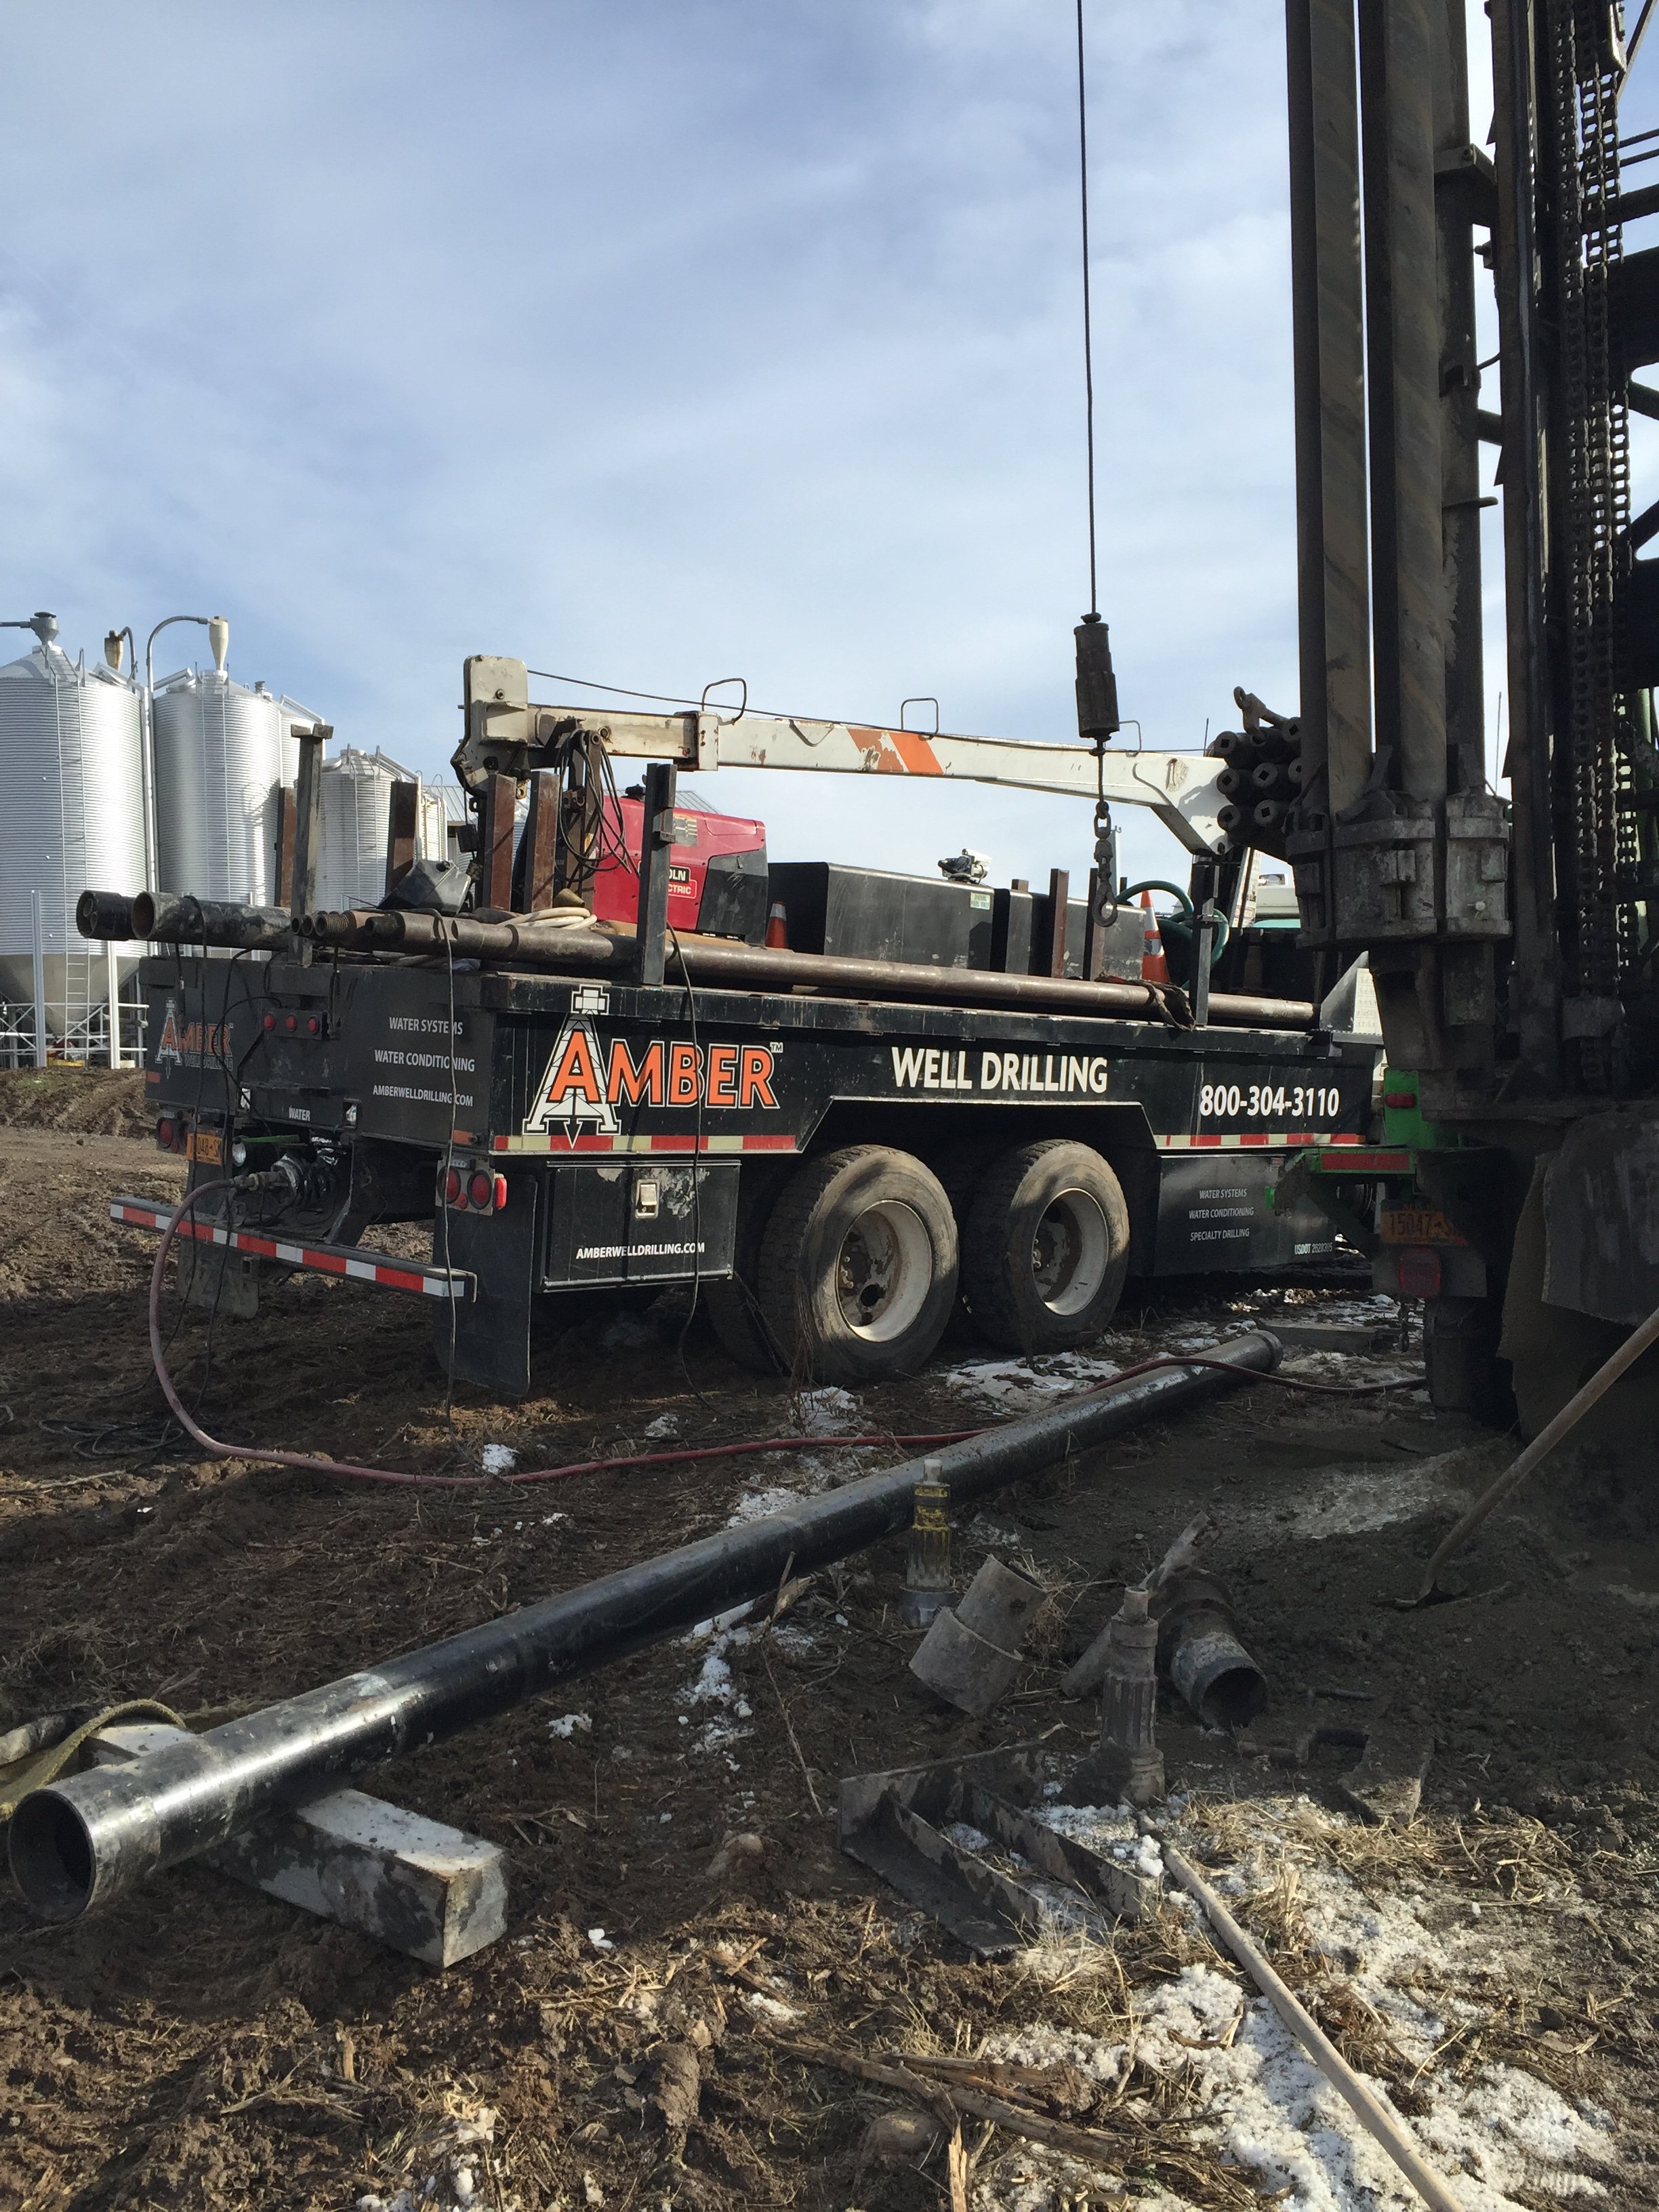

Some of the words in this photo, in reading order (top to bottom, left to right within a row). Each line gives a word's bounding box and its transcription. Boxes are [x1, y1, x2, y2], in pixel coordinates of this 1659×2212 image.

[668, 884, 691, 895] CTRIC
[389, 1017, 419, 1031] WATER
[375, 1049, 405, 1065] WATER
[406, 1052, 475, 1072] CONDITIONING
[548, 1029, 781, 1109] AMBER
[891, 1046, 972, 1090] WELL
[981, 1052, 1108, 1093] DRILLING
[373, 1085, 473, 1107] AMBERWELLDRILLINGCOM
[1200, 1084, 1339, 1117] 800-304-3110
[289, 1107, 310, 1122] WATER
[1199, 1189, 1220, 1199] WATER
[1220, 1188, 1248, 1198] SYSTEMS
[1189, 1209, 1209, 1219] WATER
[1210, 1207, 1254, 1218] CONDITIONING
[1190, 1230, 1222, 1242] SPECIALTY
[1223, 1228, 1250, 1239] DRILLING
[575, 1242, 705, 1260] AMBERWELLDRILLING.COM
[1294, 1243, 1311, 1255] USDOT
